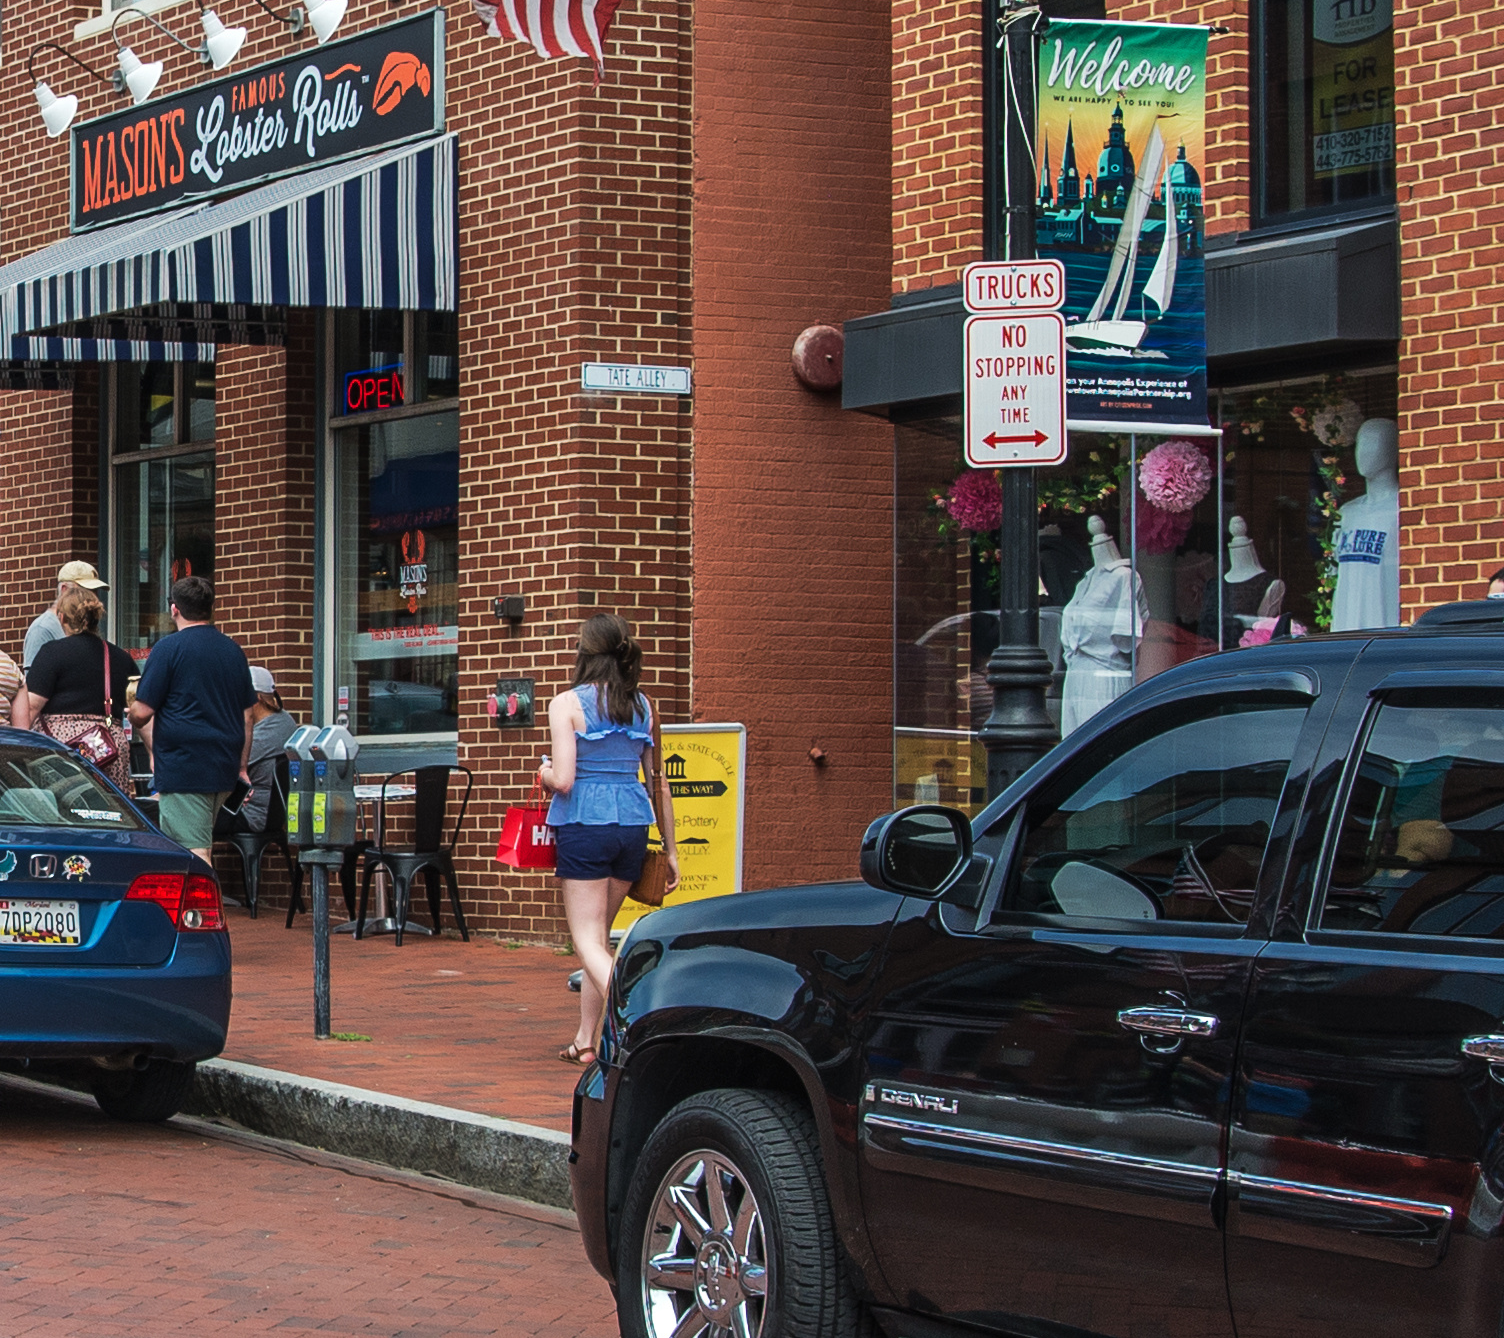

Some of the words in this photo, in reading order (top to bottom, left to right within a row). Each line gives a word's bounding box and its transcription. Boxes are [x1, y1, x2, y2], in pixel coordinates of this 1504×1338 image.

[1047, 35, 1196, 96] Welcome
[231, 71, 286, 114] FAMOUS
[190, 94, 289, 183] Lobster
[292, 64, 363, 157] Rolls
[82, 107, 186, 213] MASON'S
[976, 273, 1054, 300] TRUCKS
[1002, 325, 1027, 348] NO
[607, 367, 632, 387] TATE
[635, 369, 668, 389] ALLEY
[975, 356, 1056, 379] STOPPING
[347, 370, 405, 410] OPEN
[1001, 385, 1028, 402] ANY
[1078, 378, 1096, 387] your
[1097, 377, 1135, 388] Annapolis
[1135, 378, 1177, 389] Experience
[1000, 407, 1030, 424] TIME
[1352, 541, 1384, 555] LURE
[1355, 529, 1387, 544] PURE
[685, 743, 710, 755] STATE
[711, 750, 736, 777] CIRCLE
[672, 785, 690, 795] THIS
[691, 784, 714, 794] WAY!
[682, 814, 720, 830] Pottery
[1, 911, 76, 934] 7DP2080
[881, 1087, 959, 1114] DENALI
